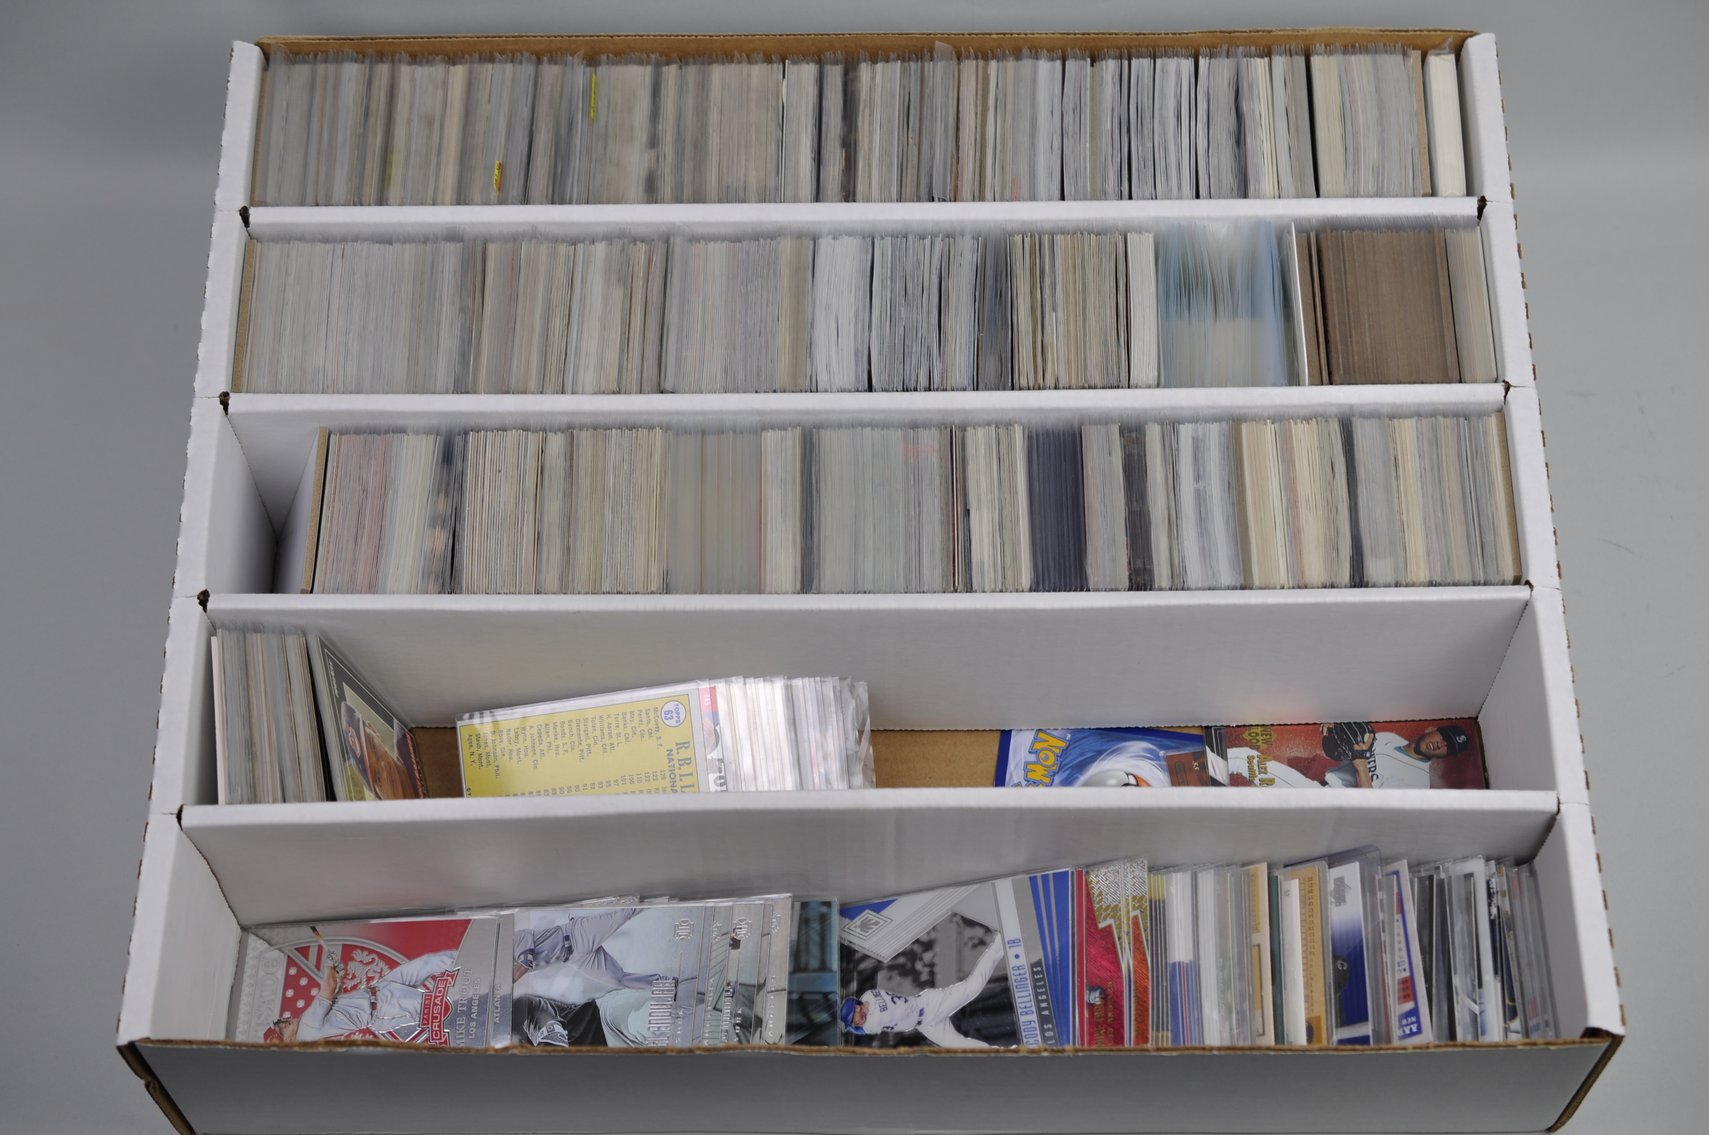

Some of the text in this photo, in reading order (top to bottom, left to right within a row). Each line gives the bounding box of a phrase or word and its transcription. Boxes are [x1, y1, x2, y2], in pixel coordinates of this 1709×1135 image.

[664, 710, 673, 720] 63
[433, 980, 445, 1039] CRUSADE
[458, 968, 472, 1013] TROUT
[471, 979, 480, 1018] ANGELES
[1007, 938, 1040, 1046] CODY BELLINGER 1B
[1033, 967, 1055, 1043] LOS ANGELES
